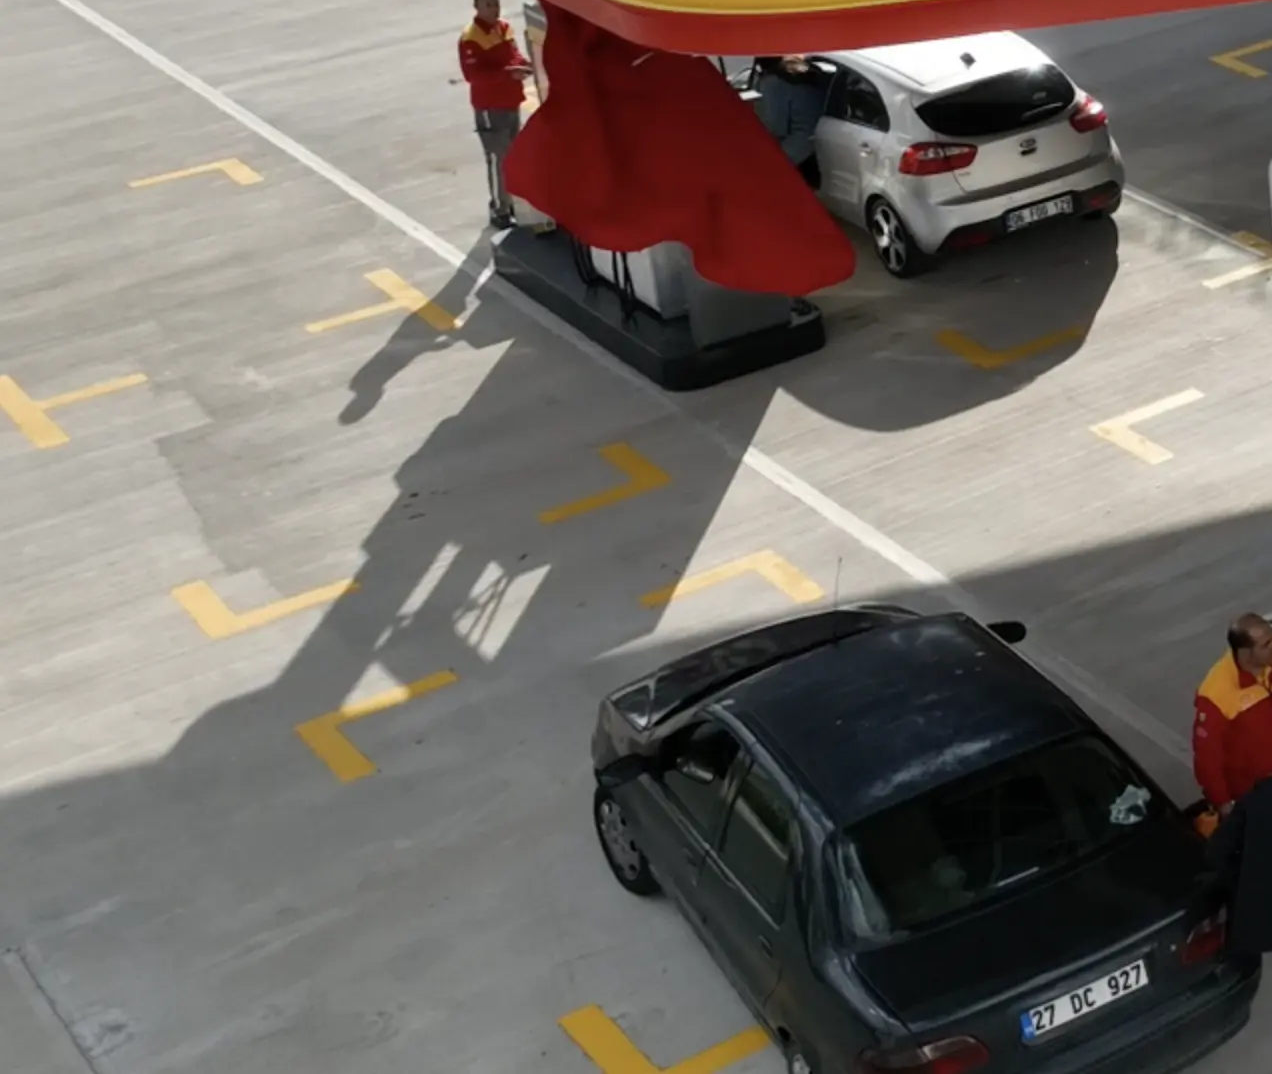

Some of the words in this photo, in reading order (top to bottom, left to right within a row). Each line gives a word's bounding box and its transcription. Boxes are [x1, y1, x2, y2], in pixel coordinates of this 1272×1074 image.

[1033, 1004, 1056, 1031] 27
[1069, 987, 1096, 1015] DC
[1107, 964, 1141, 996] 927
